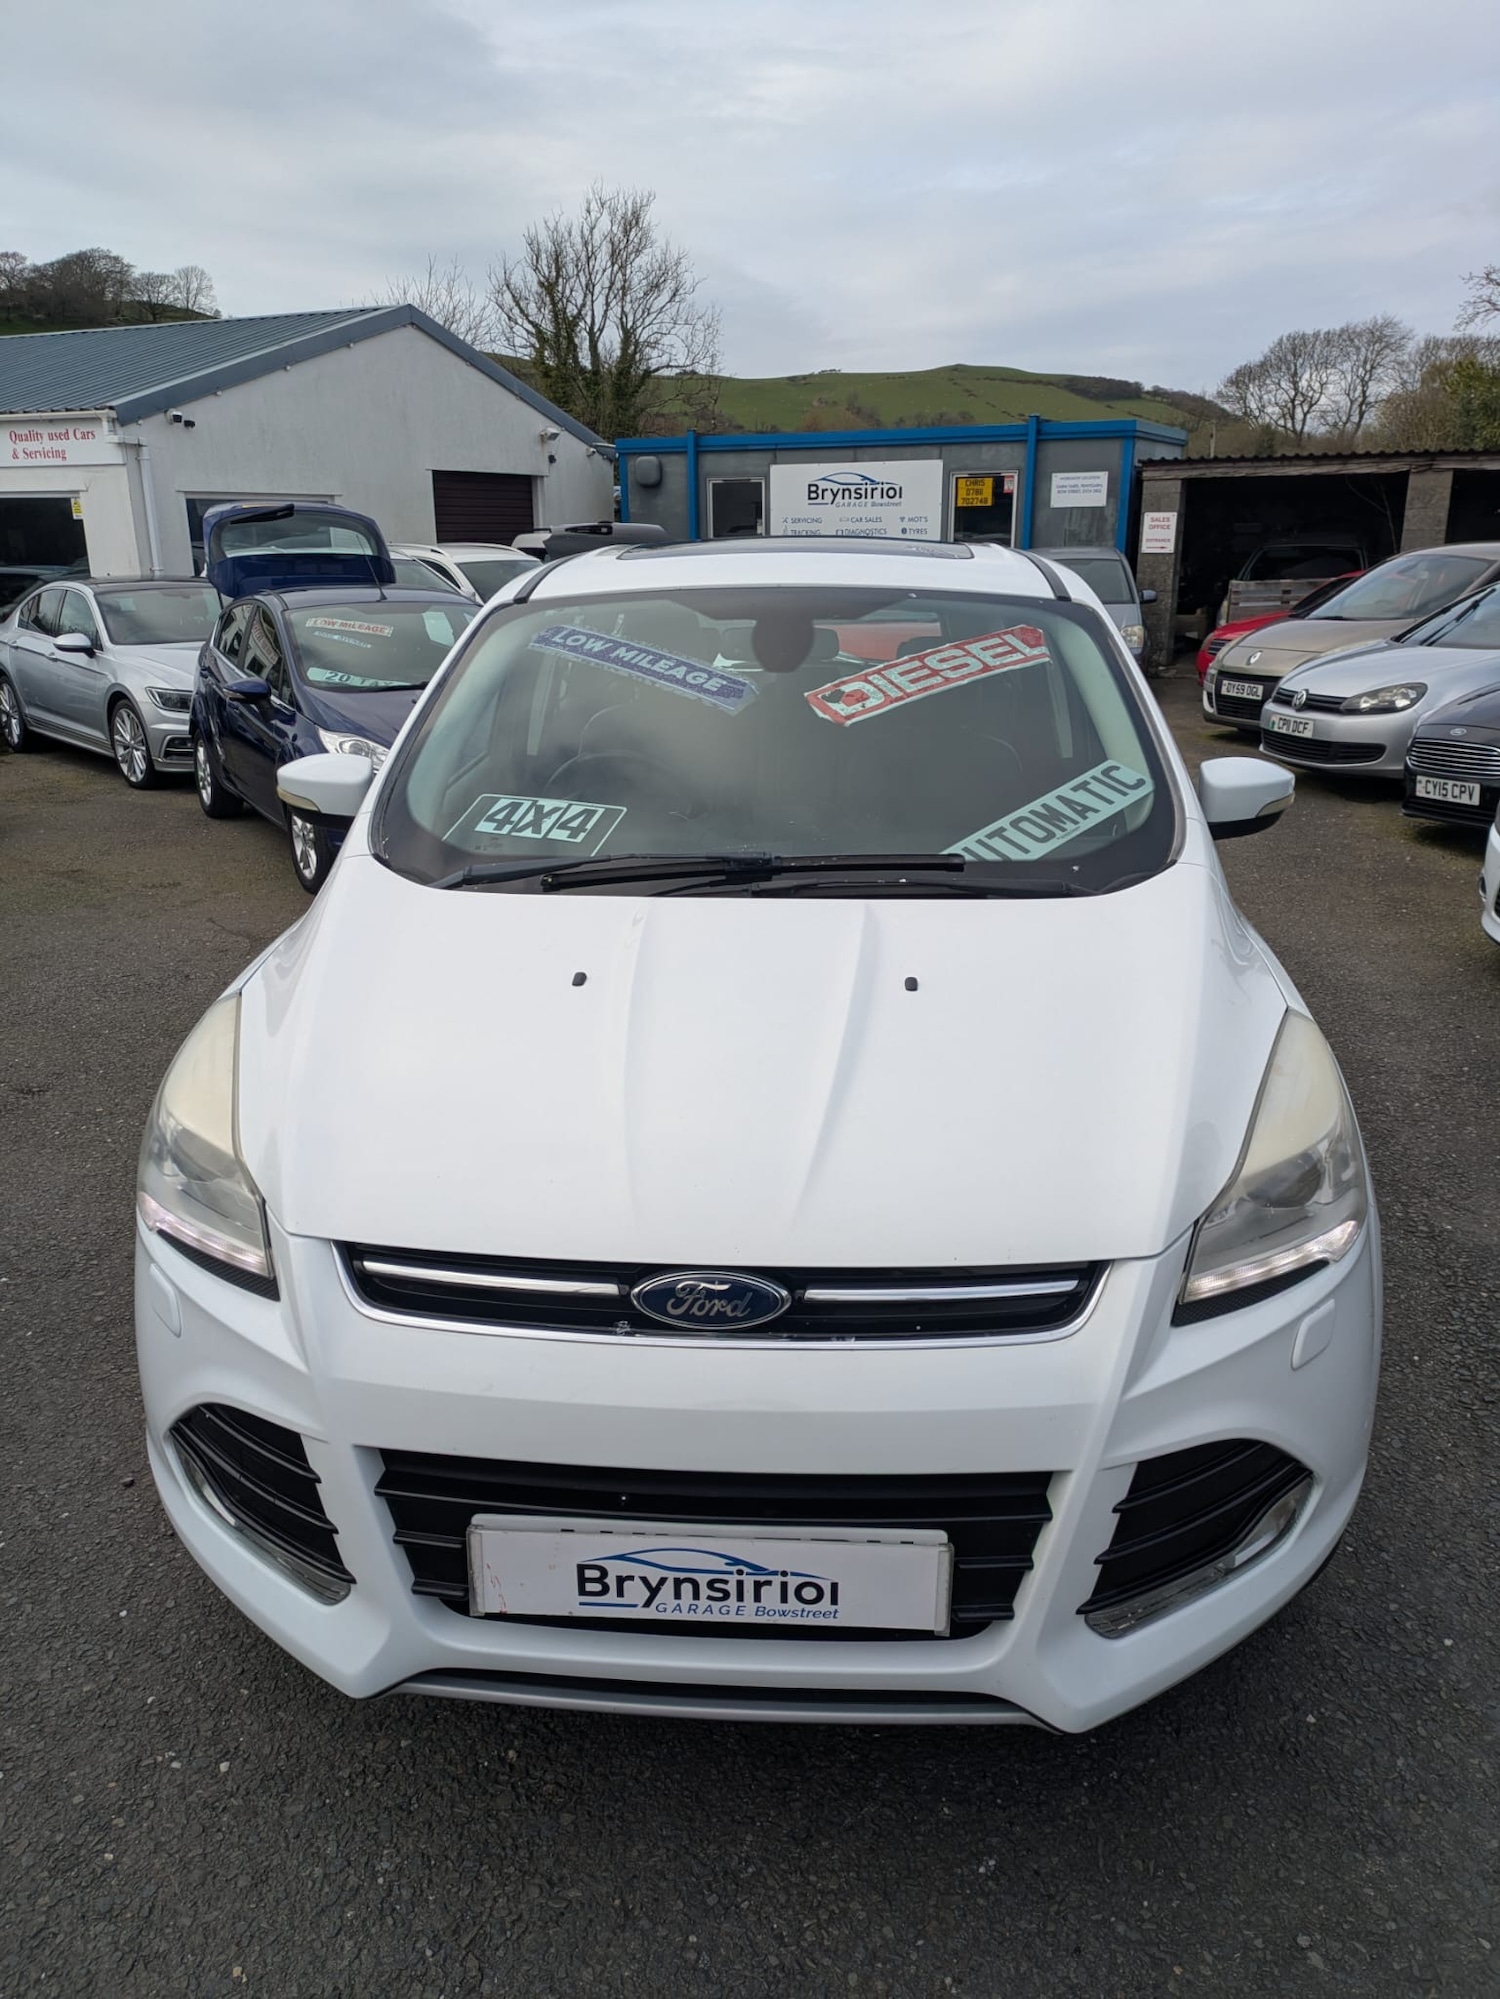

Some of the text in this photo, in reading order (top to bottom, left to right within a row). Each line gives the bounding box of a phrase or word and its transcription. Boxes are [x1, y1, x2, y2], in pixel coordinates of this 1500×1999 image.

[9, 428, 96, 444] Quality used Cars
[12, 447, 67, 461] & Servicing
[808, 483, 902, 505] Brynsiriol
[845, 528, 887, 536] DIAGNOSTICS
[313, 619, 388, 634] LOW MILEAGE
[552, 630, 727, 692] LOW MILEAGE
[325, 671, 352, 682] 20
[819, 634, 1049, 717] DIESEL
[1277, 717, 1309, 735] CP11 DCF
[1425, 779, 1475, 802] CY15 CPV
[483, 801, 598, 840] 4X4
[961, 765, 1147, 861] UTOMATIC
[666, 1280, 752, 1318] Ford
[577, 1563, 839, 1609] Brynsiriol
[656, 1602, 839, 1619] GARAGE Bowstreet
